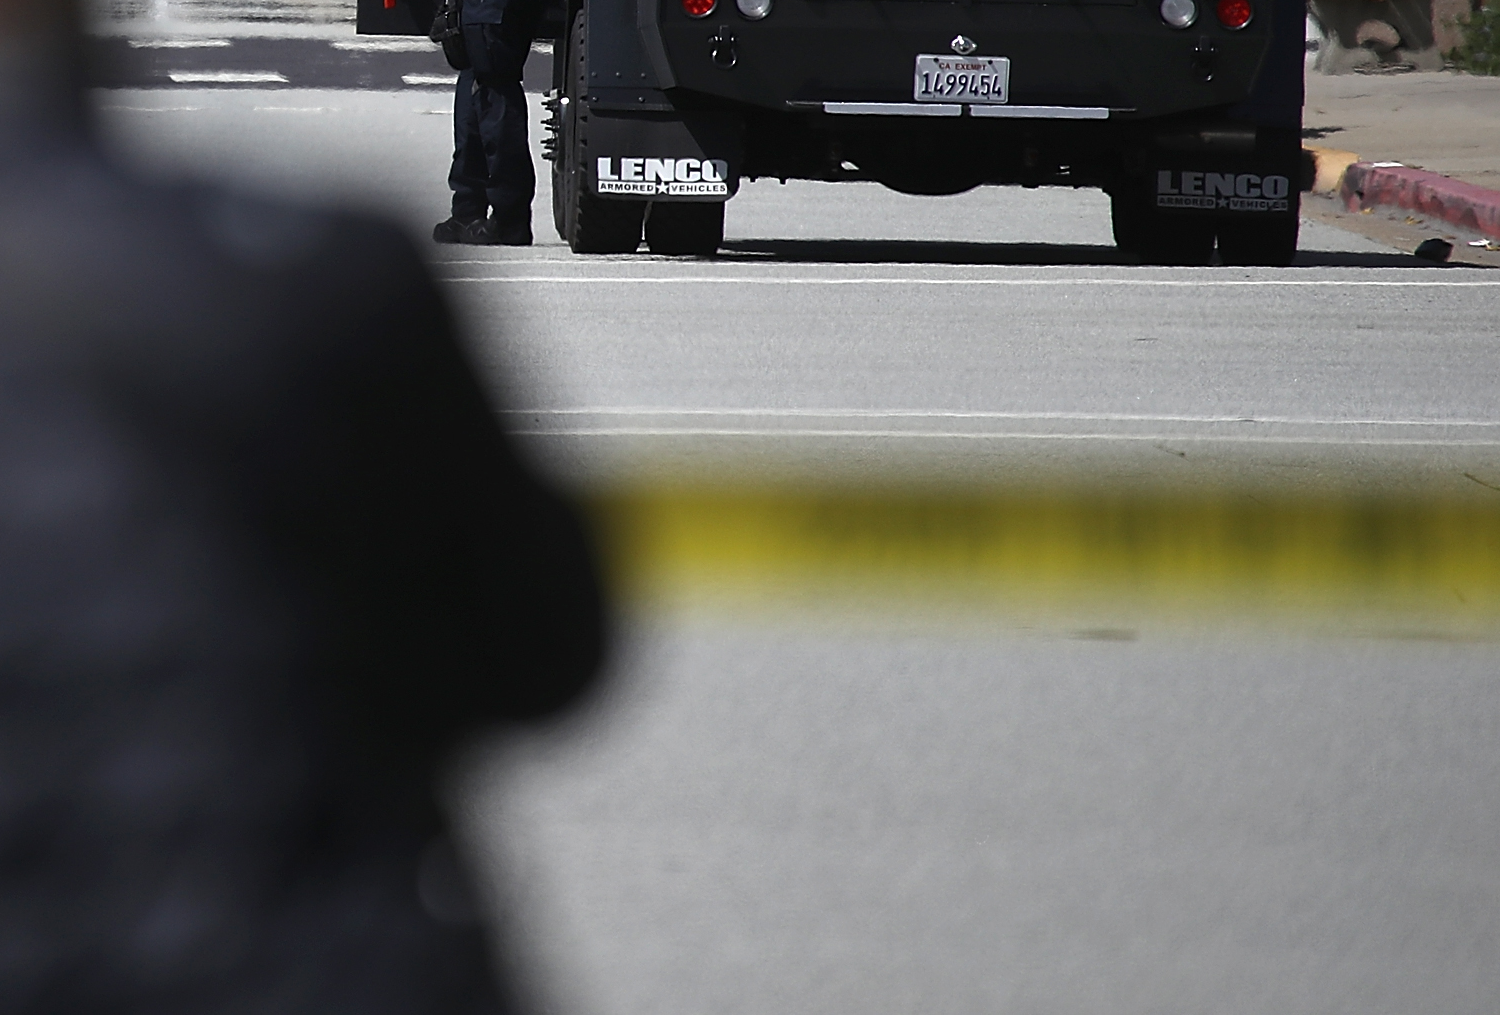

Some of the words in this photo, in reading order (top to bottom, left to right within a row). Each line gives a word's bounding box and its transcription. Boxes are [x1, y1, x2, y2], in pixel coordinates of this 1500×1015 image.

[938, 62, 951, 70] CA
[954, 63, 987, 71] EXEMPT
[920, 71, 1003, 98] 1499454
[597, 157, 728, 182] LENCO
[600, 183, 654, 192] ARMORED
[671, 184, 726, 192] VEHICLES
[1158, 171, 1288, 198] LENCO
[1159, 196, 1215, 207] ARMORED
